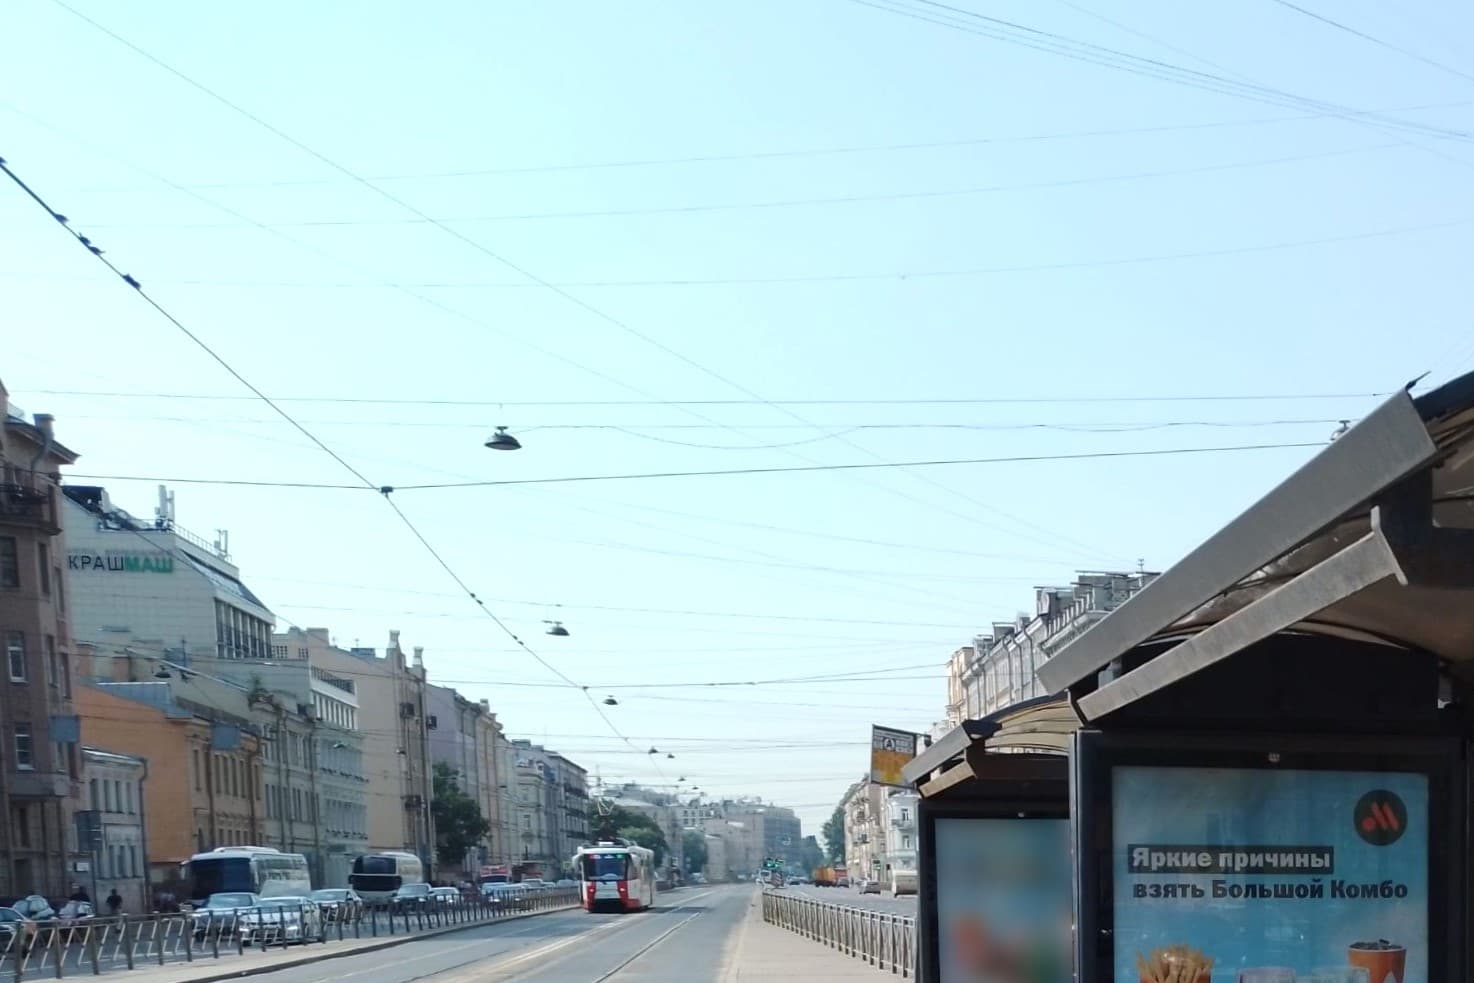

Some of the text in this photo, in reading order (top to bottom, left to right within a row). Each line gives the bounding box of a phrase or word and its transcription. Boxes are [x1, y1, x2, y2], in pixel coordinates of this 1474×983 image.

[1132, 848, 1330, 871] Яркие причины
[1133, 878, 1408, 898] взять Большой Комбо
